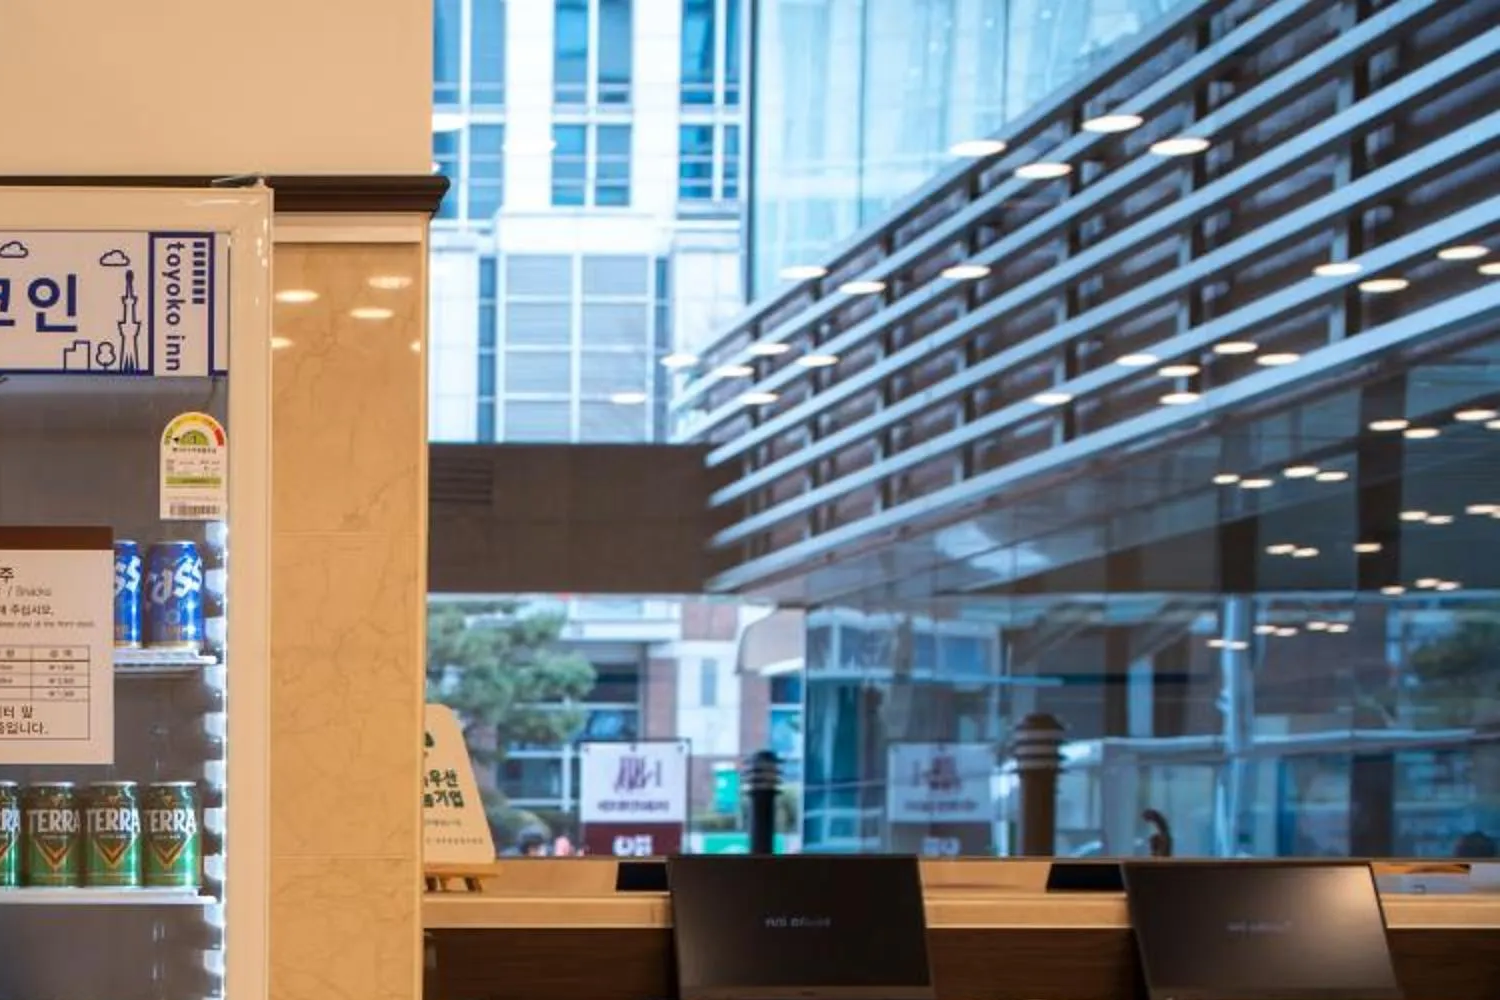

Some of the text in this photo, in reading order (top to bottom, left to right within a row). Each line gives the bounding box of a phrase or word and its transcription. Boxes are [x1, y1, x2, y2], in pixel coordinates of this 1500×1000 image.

[161, 241, 186, 371] toyoko inn
[26, 808, 80, 833] TERRA
[85, 808, 141, 833] TERRA
